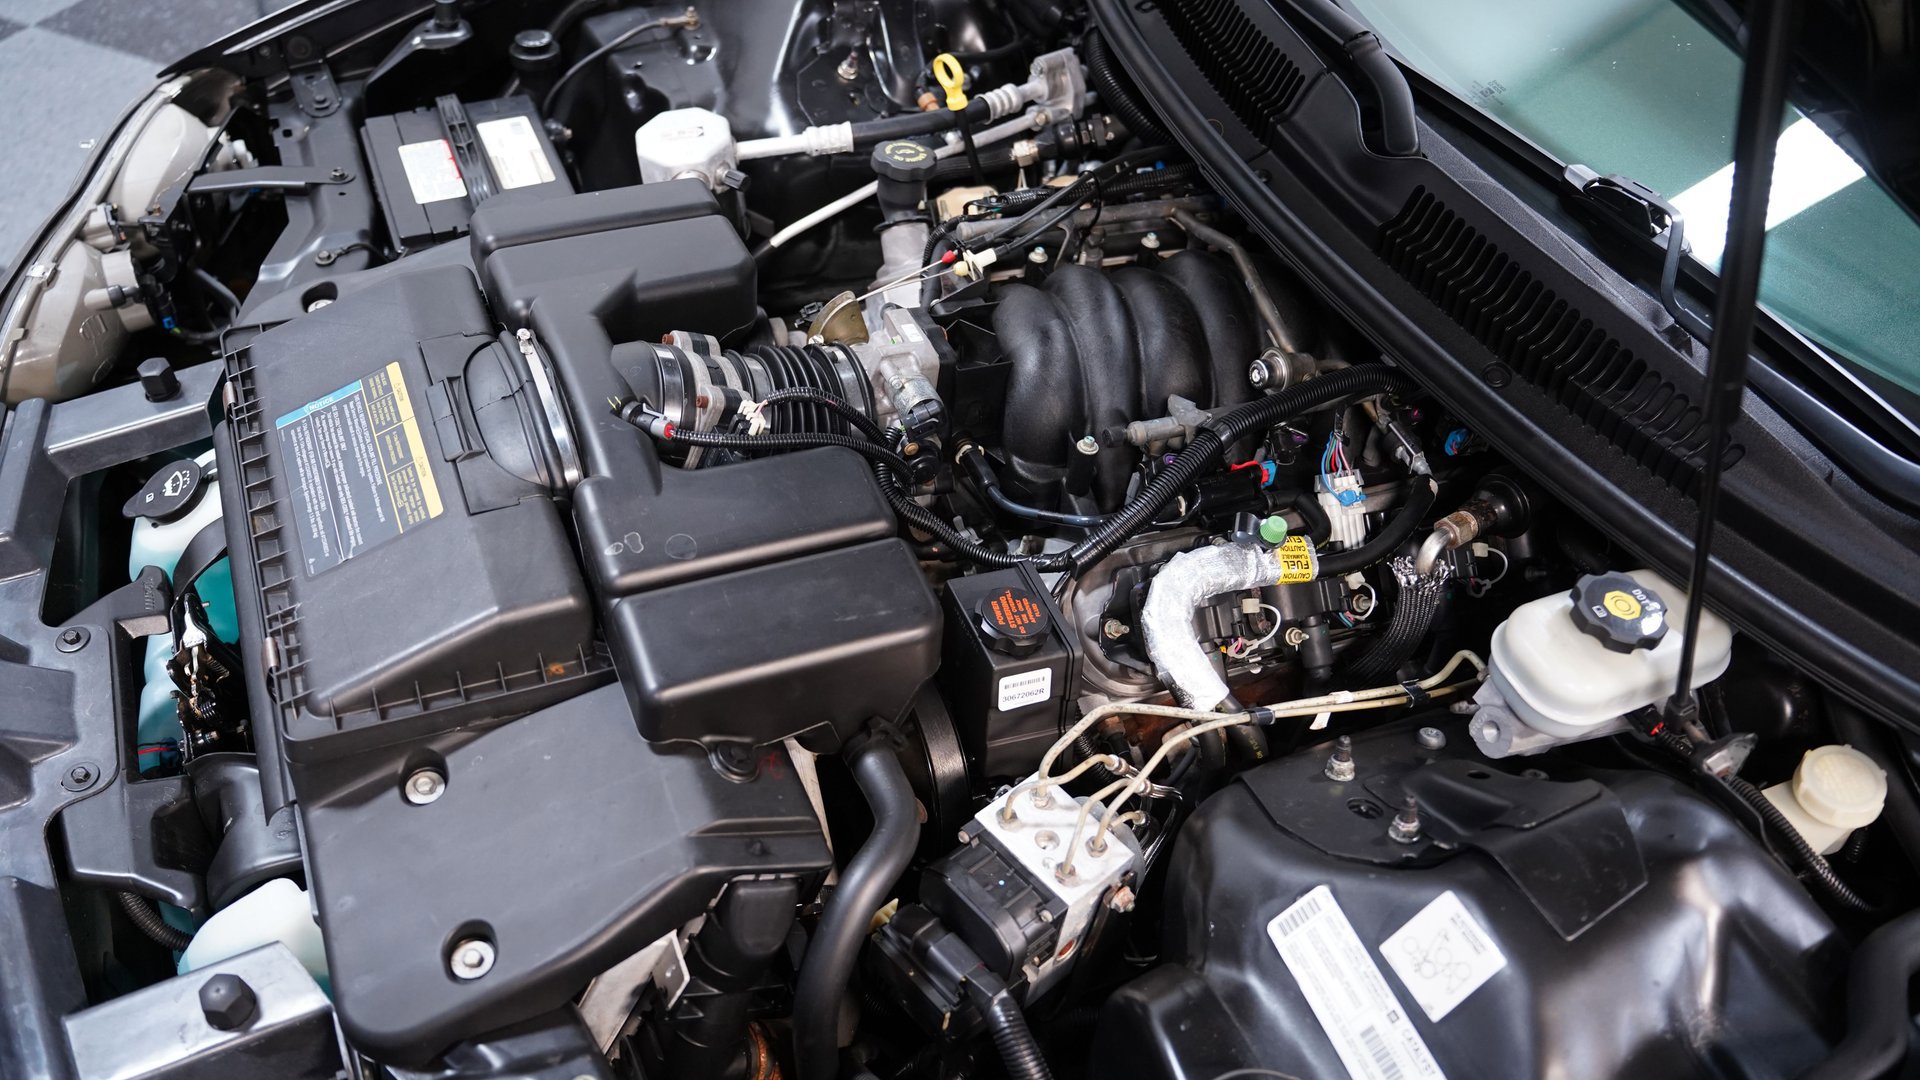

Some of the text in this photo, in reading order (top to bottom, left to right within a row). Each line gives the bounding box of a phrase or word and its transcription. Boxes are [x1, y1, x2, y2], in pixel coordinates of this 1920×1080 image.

[309, 396, 333, 412] NOTICE
[1283, 560, 1309, 570] FUEL
[1005, 590, 1017, 612] OVERFILL
[1632, 589, 1650, 604] DOT
[991, 601, 1005, 625] POWER
[1000, 596, 1017, 628] STEERING
[1023, 598, 1036, 623] APPROVED
[1032, 603, 1040, 617] FLUID
[1014, 614, 1022, 625] NOT
[1003, 688, 1044, 702] 30672062R
